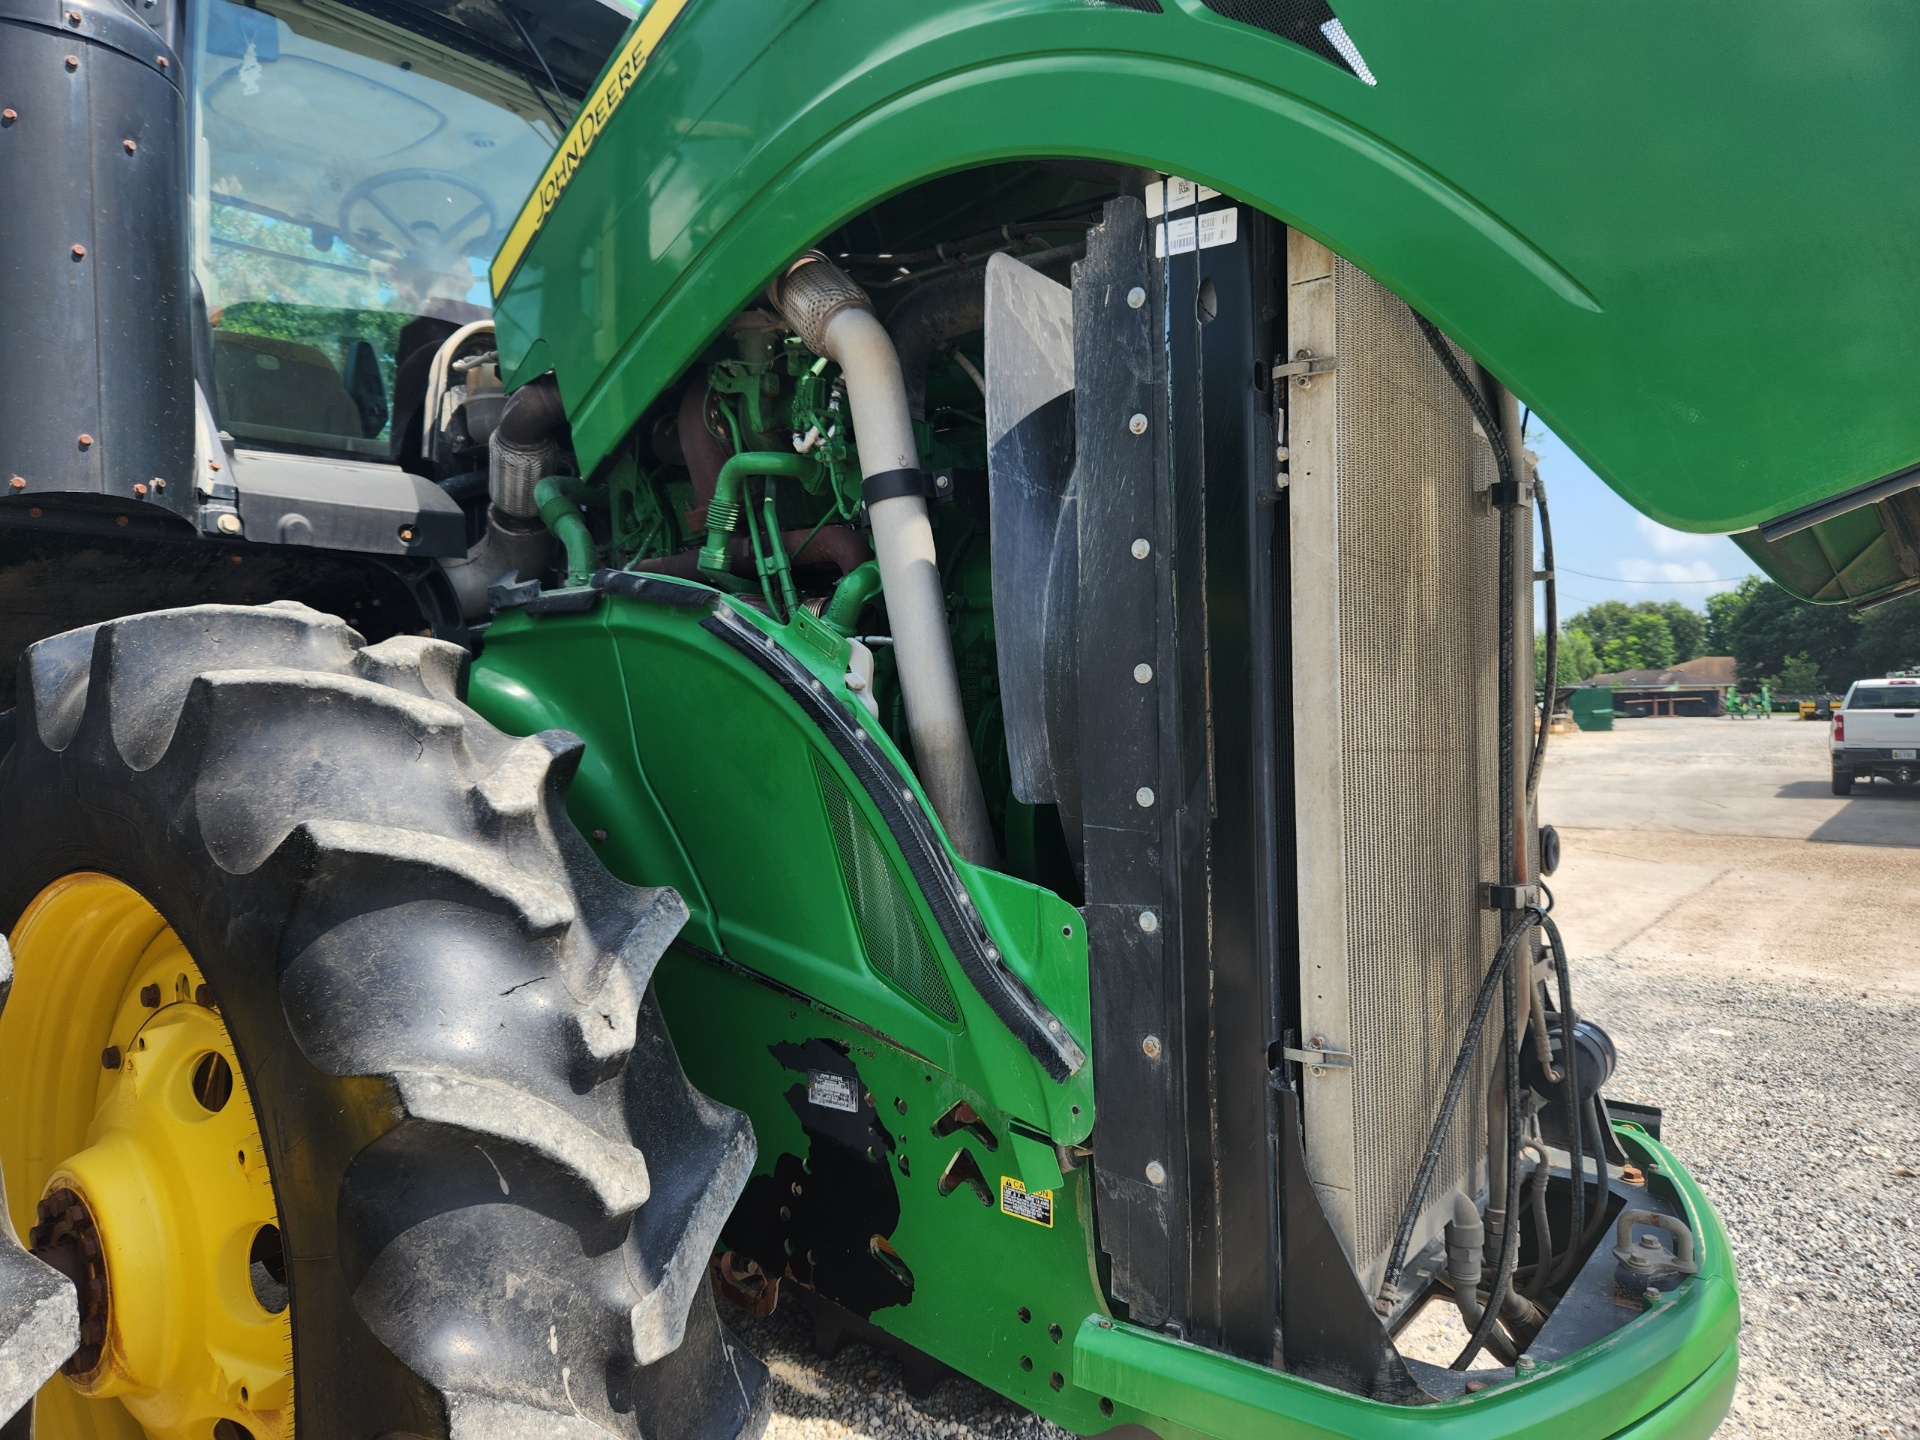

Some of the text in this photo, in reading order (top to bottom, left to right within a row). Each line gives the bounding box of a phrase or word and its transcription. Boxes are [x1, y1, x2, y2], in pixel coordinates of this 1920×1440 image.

[536, 39, 647, 224] JOHN DEERE
[1013, 1180, 1049, 1198] CAON
